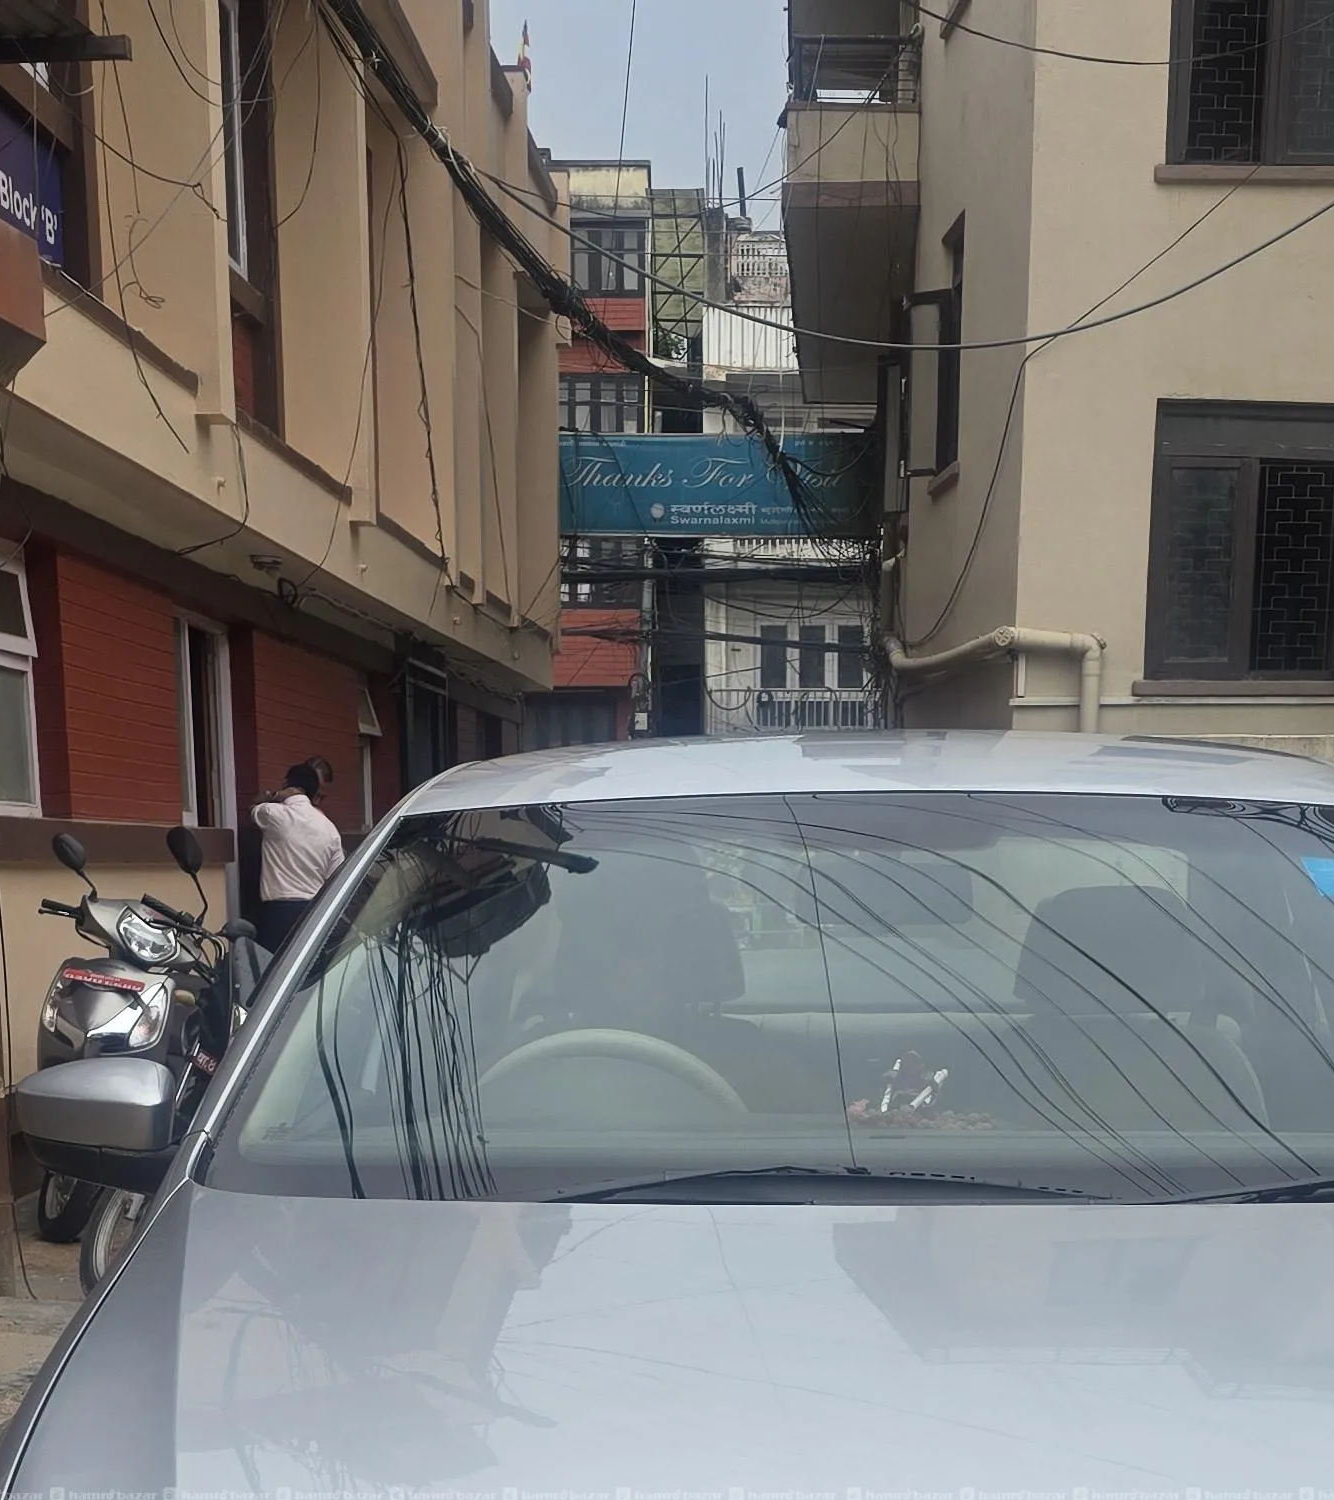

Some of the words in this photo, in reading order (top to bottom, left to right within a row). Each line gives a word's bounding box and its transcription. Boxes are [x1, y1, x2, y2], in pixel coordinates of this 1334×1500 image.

[560, 456, 674, 488] Thanks
[682, 455, 755, 489] For
[670, 515, 755, 525] Swarnalaxmi
